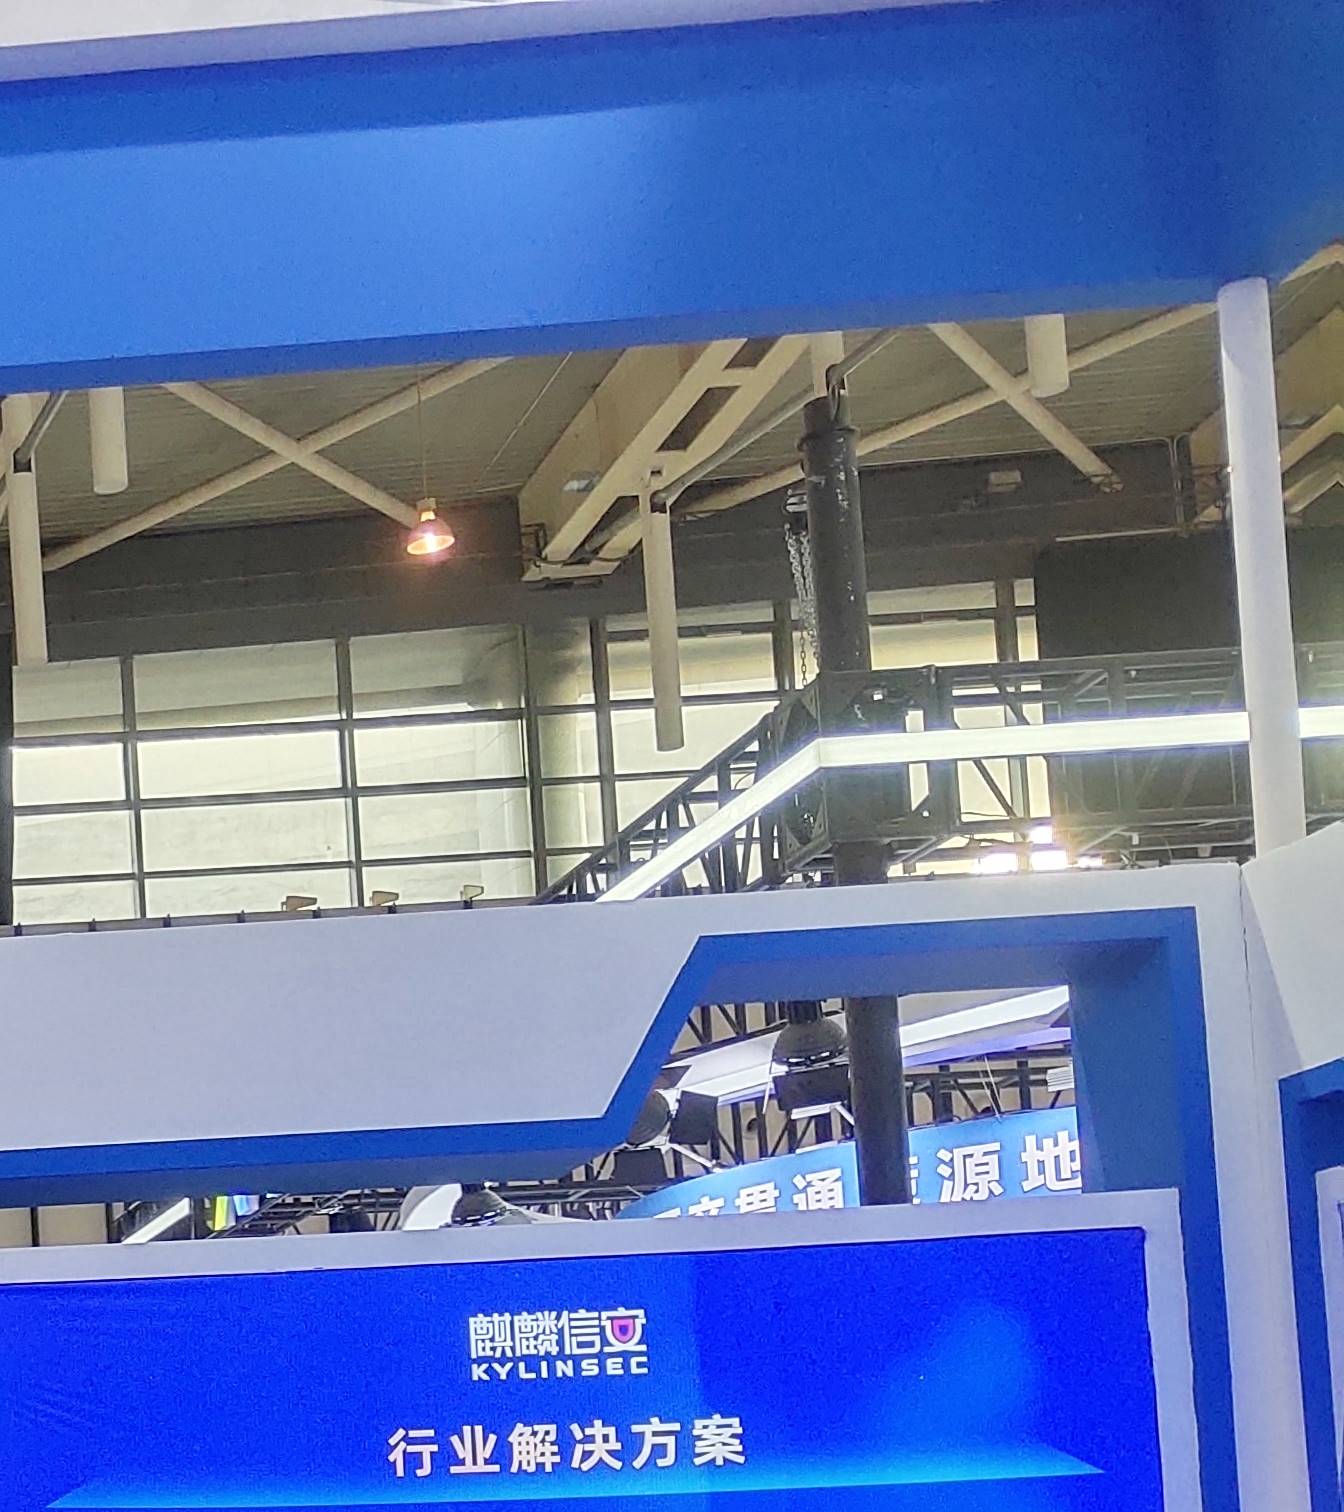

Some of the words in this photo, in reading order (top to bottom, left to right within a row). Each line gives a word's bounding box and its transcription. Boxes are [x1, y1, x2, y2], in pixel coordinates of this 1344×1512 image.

[911, 1130, 1082, 1204] 源地
[470, 1308, 646, 1357] 麒麟信安
[471, 1357, 649, 1380] KYLINSEC
[387, 1413, 747, 1477] 行业解决方案
